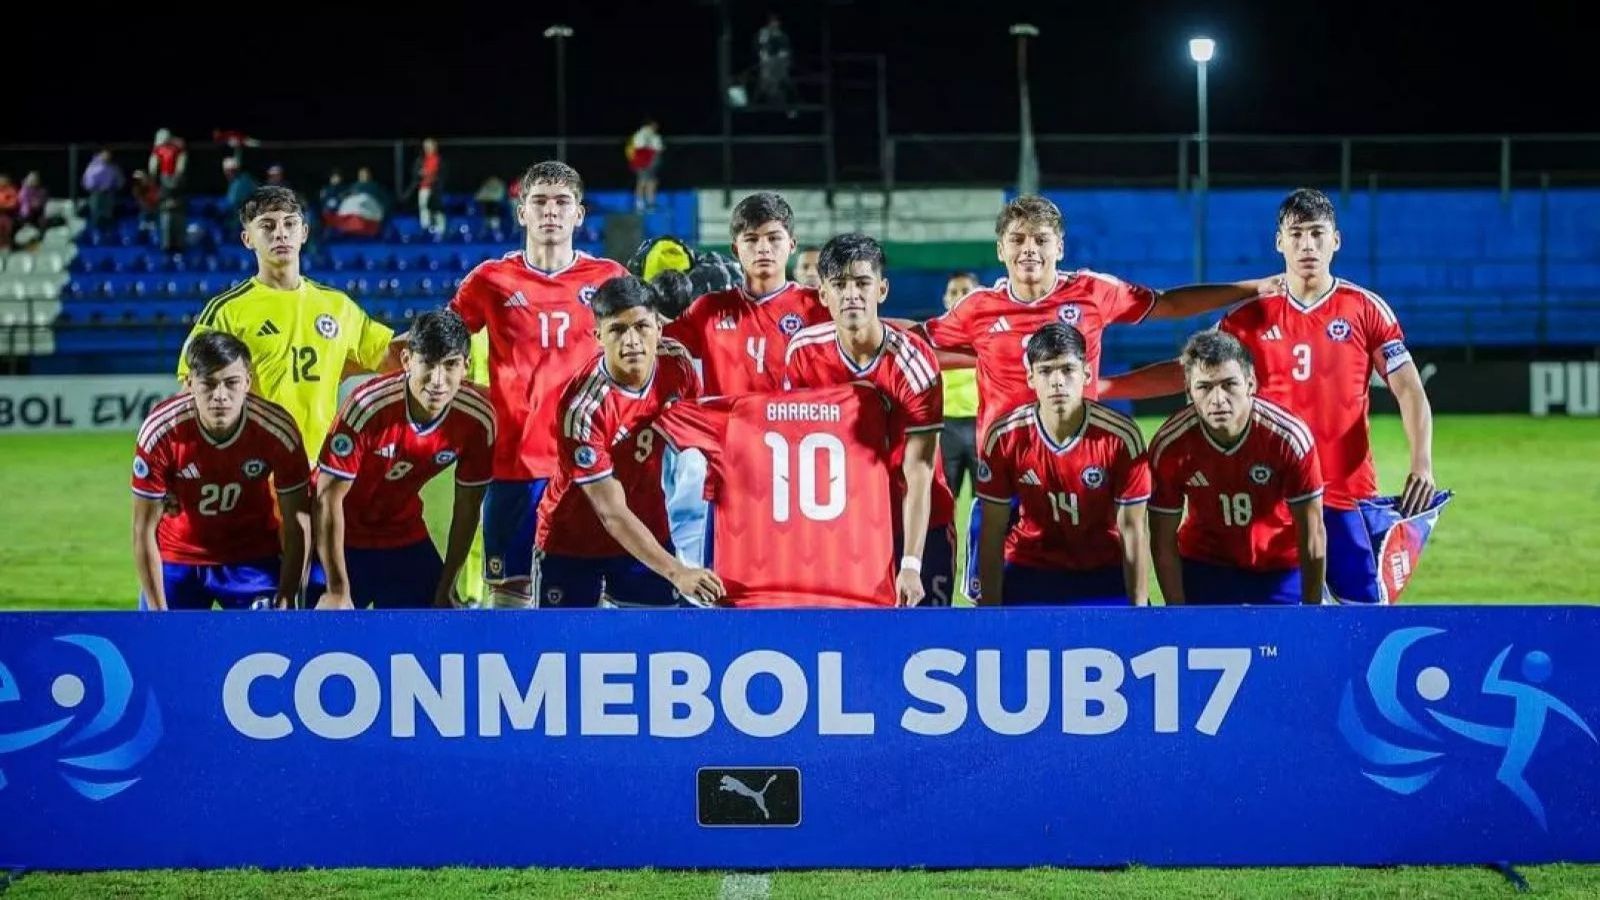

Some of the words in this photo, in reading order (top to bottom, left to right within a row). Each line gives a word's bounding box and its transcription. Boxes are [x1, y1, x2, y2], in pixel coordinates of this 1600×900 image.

[538, 311, 570, 349] 17
[291, 346, 321, 383] 12
[747, 336, 766, 374] 4
[1292, 343, 1312, 381] 3
[1529, 361, 1599, 416] PU
[766, 402, 840, 422] BARRERA
[634, 427, 654, 464] 9
[385, 460, 413, 481] 8
[764, 431, 847, 523] 10
[199, 483, 242, 517] 20
[1048, 491, 1079, 526] 14
[1219, 493, 1252, 526] 18
[222, 649, 875, 740] CONMEBOL
[899, 645, 1252, 737] SUB17
